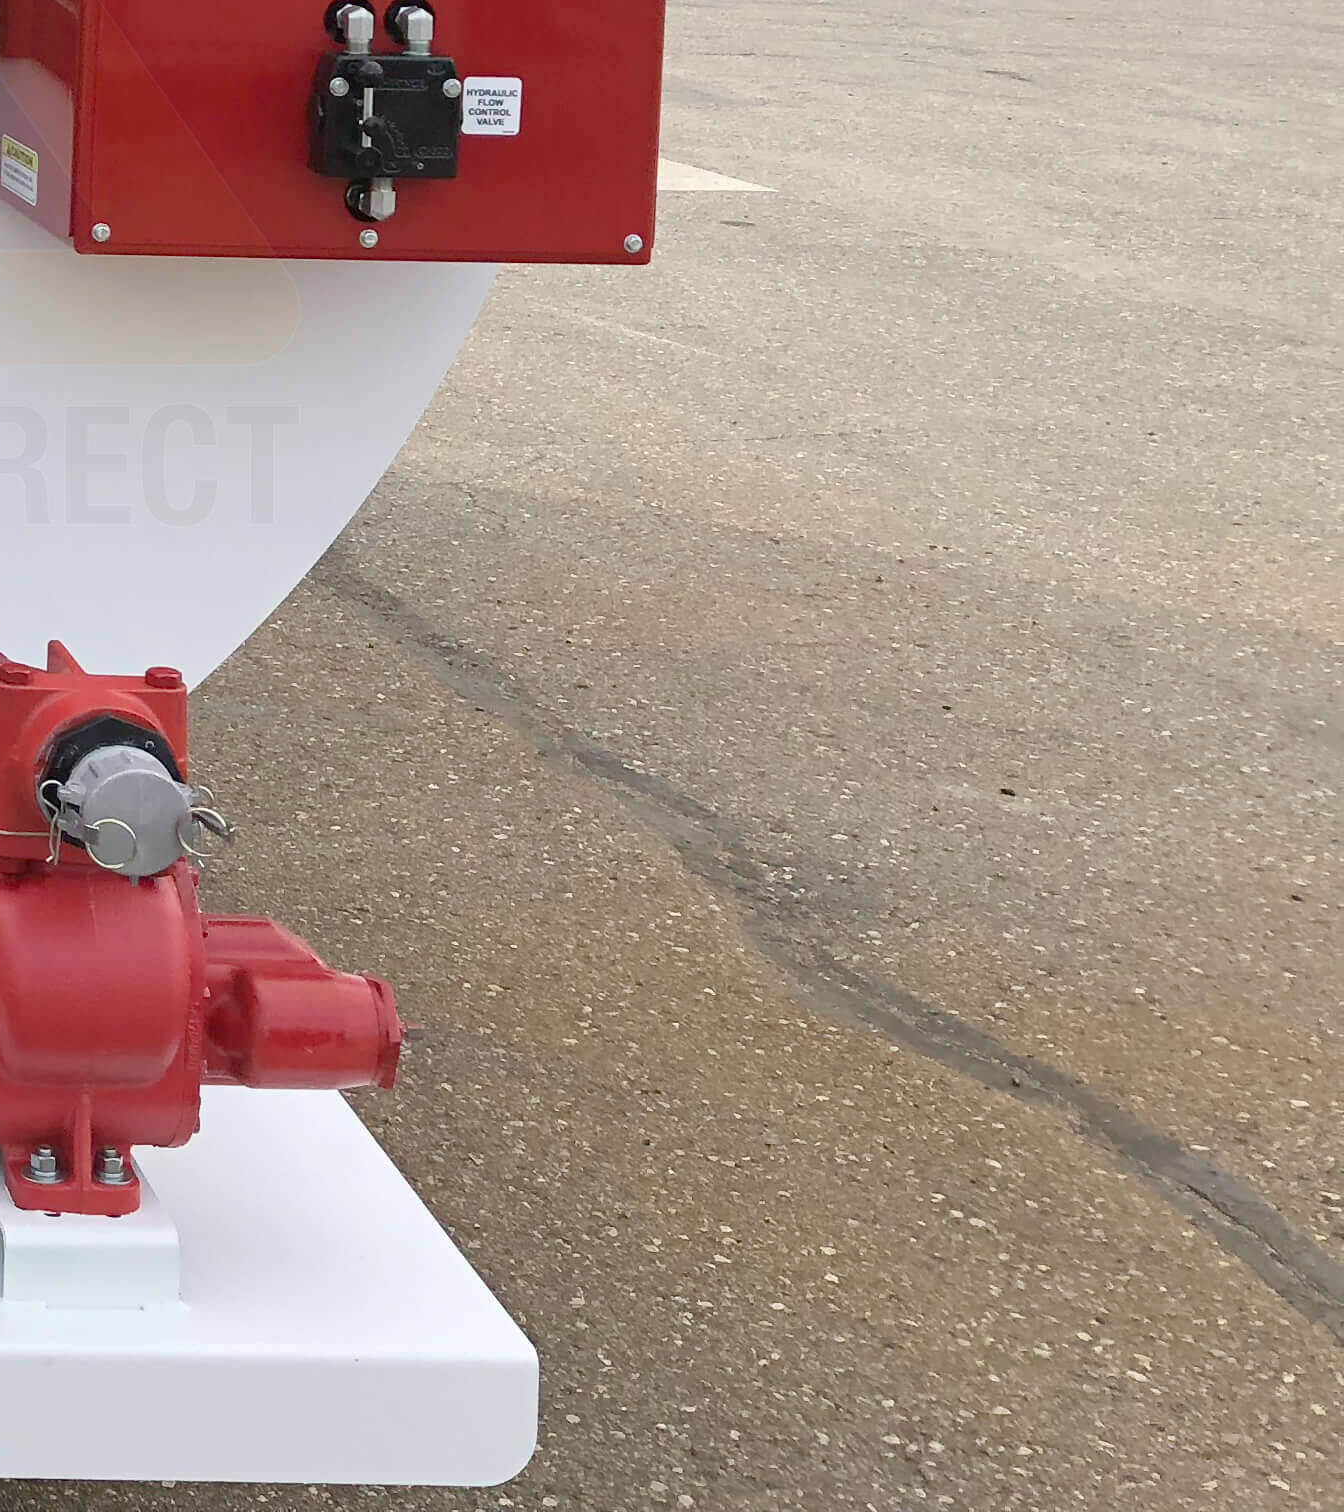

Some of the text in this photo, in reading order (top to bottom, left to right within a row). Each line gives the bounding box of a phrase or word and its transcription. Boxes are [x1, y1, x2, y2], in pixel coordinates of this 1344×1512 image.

[466, 89, 518, 97] HYDRAULIC
[468, 108, 512, 116] CONTROL
[476, 118, 505, 126] VALVE
